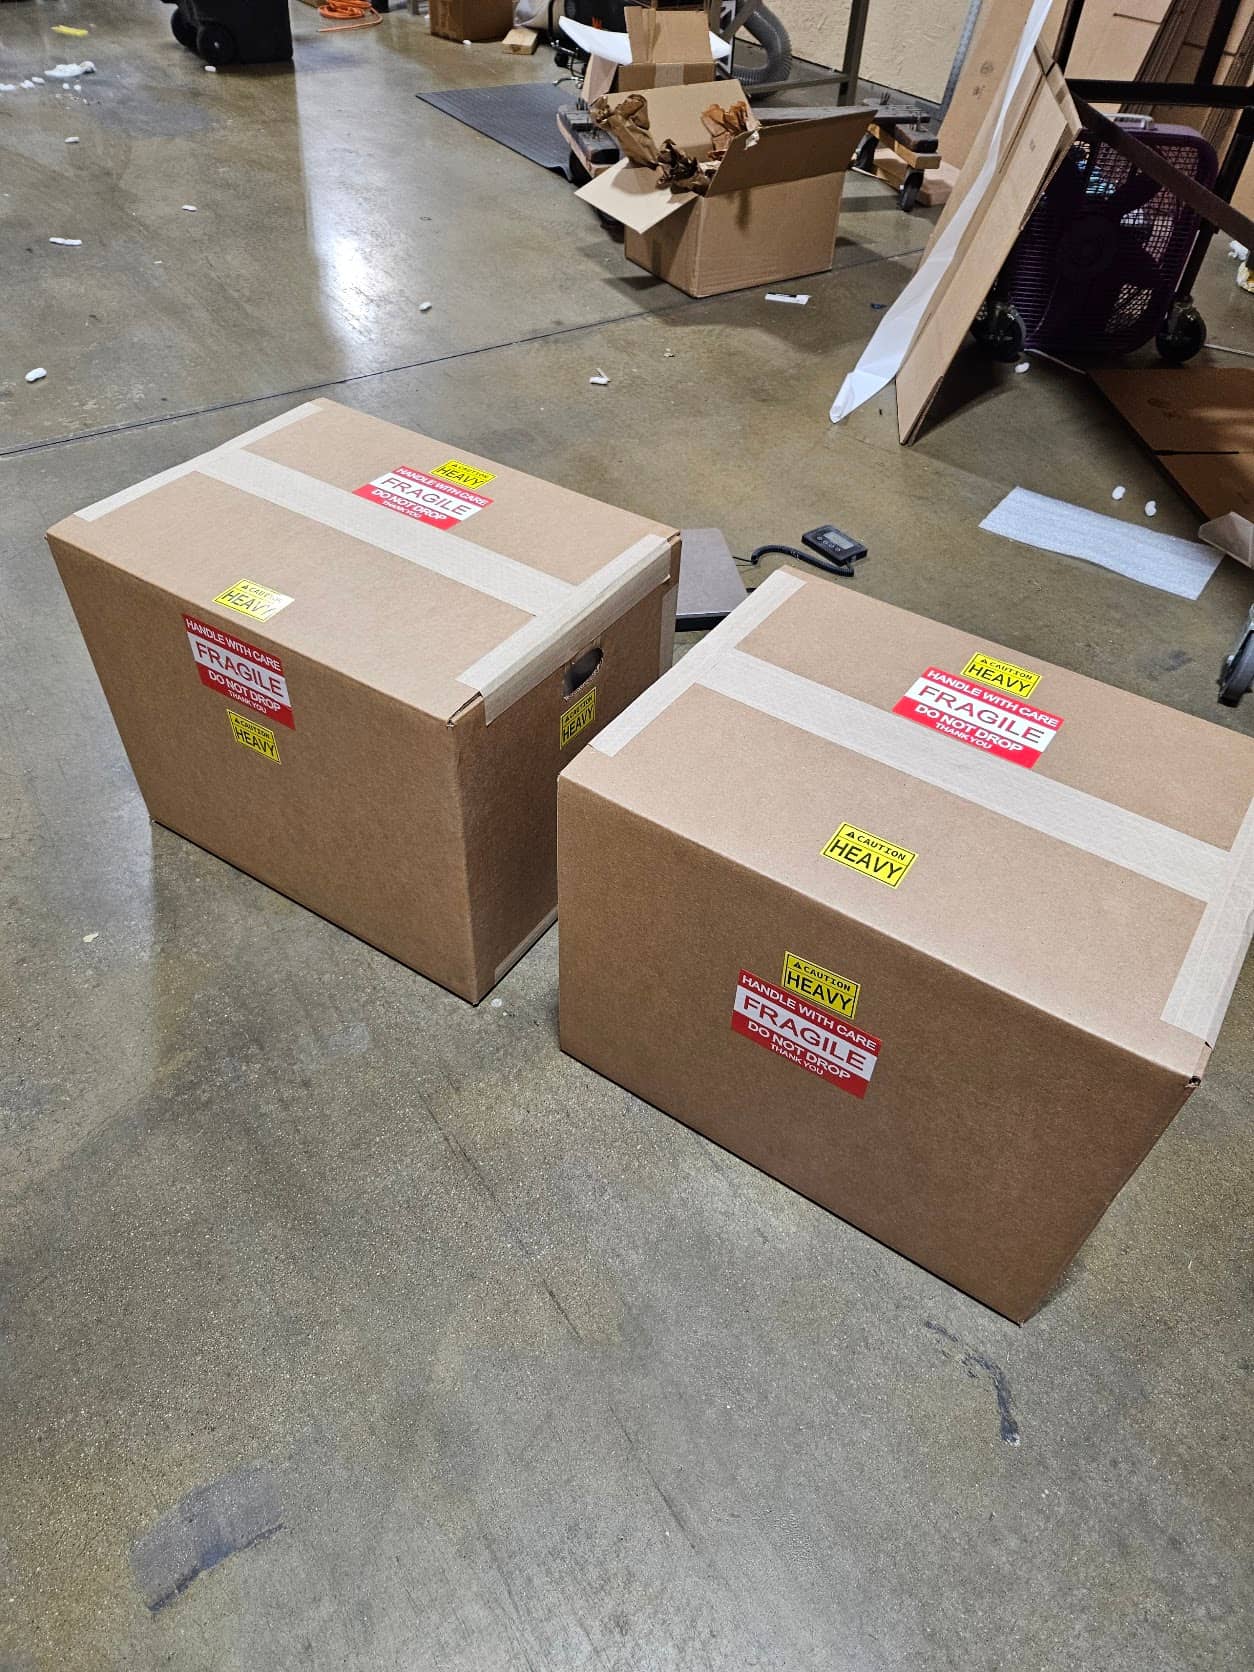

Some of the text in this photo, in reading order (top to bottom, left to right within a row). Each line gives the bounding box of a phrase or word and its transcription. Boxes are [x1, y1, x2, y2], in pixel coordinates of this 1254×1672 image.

[396, 468, 489, 506] HANDLE WITH CARE
[436, 467, 484, 487] HEAVY
[371, 489, 448, 520] DO NOT DROP
[381, 477, 472, 516] FRAGILE
[382, 500, 422, 518] THANK YOU
[221, 590, 276, 615] HEAVY
[185, 618, 282, 671] HANDLE WITH CARE
[195, 640, 284, 698] FRAGILE
[968, 663, 1031, 692] HEAVY
[989, 661, 1033, 680] CAUTION
[208, 669, 281, 712] DO NOT DROP
[227, 689, 267, 713] THANK YOU
[927, 670, 1059, 727] HANDLE WITH CARE
[562, 706, 593, 742] HEAVY
[915, 704, 1024, 751] DO NOT DROP
[918, 684, 1045, 744] FRAGILE
[234, 726, 275, 756] HEAVY
[935, 722, 993, 749] THANK YOU
[829, 839, 903, 879] HEAVY
[857, 835, 906, 861] CAUTION
[787, 971, 853, 1011] HEAVY
[803, 966, 851, 992] CAUTION
[742, 974, 877, 1050] HANDLE WITH CARE
[743, 994, 867, 1072] FRAGILE
[747, 1020, 851, 1079] DO NOT DROP
[770, 1043, 824, 1076] THANK YOU
